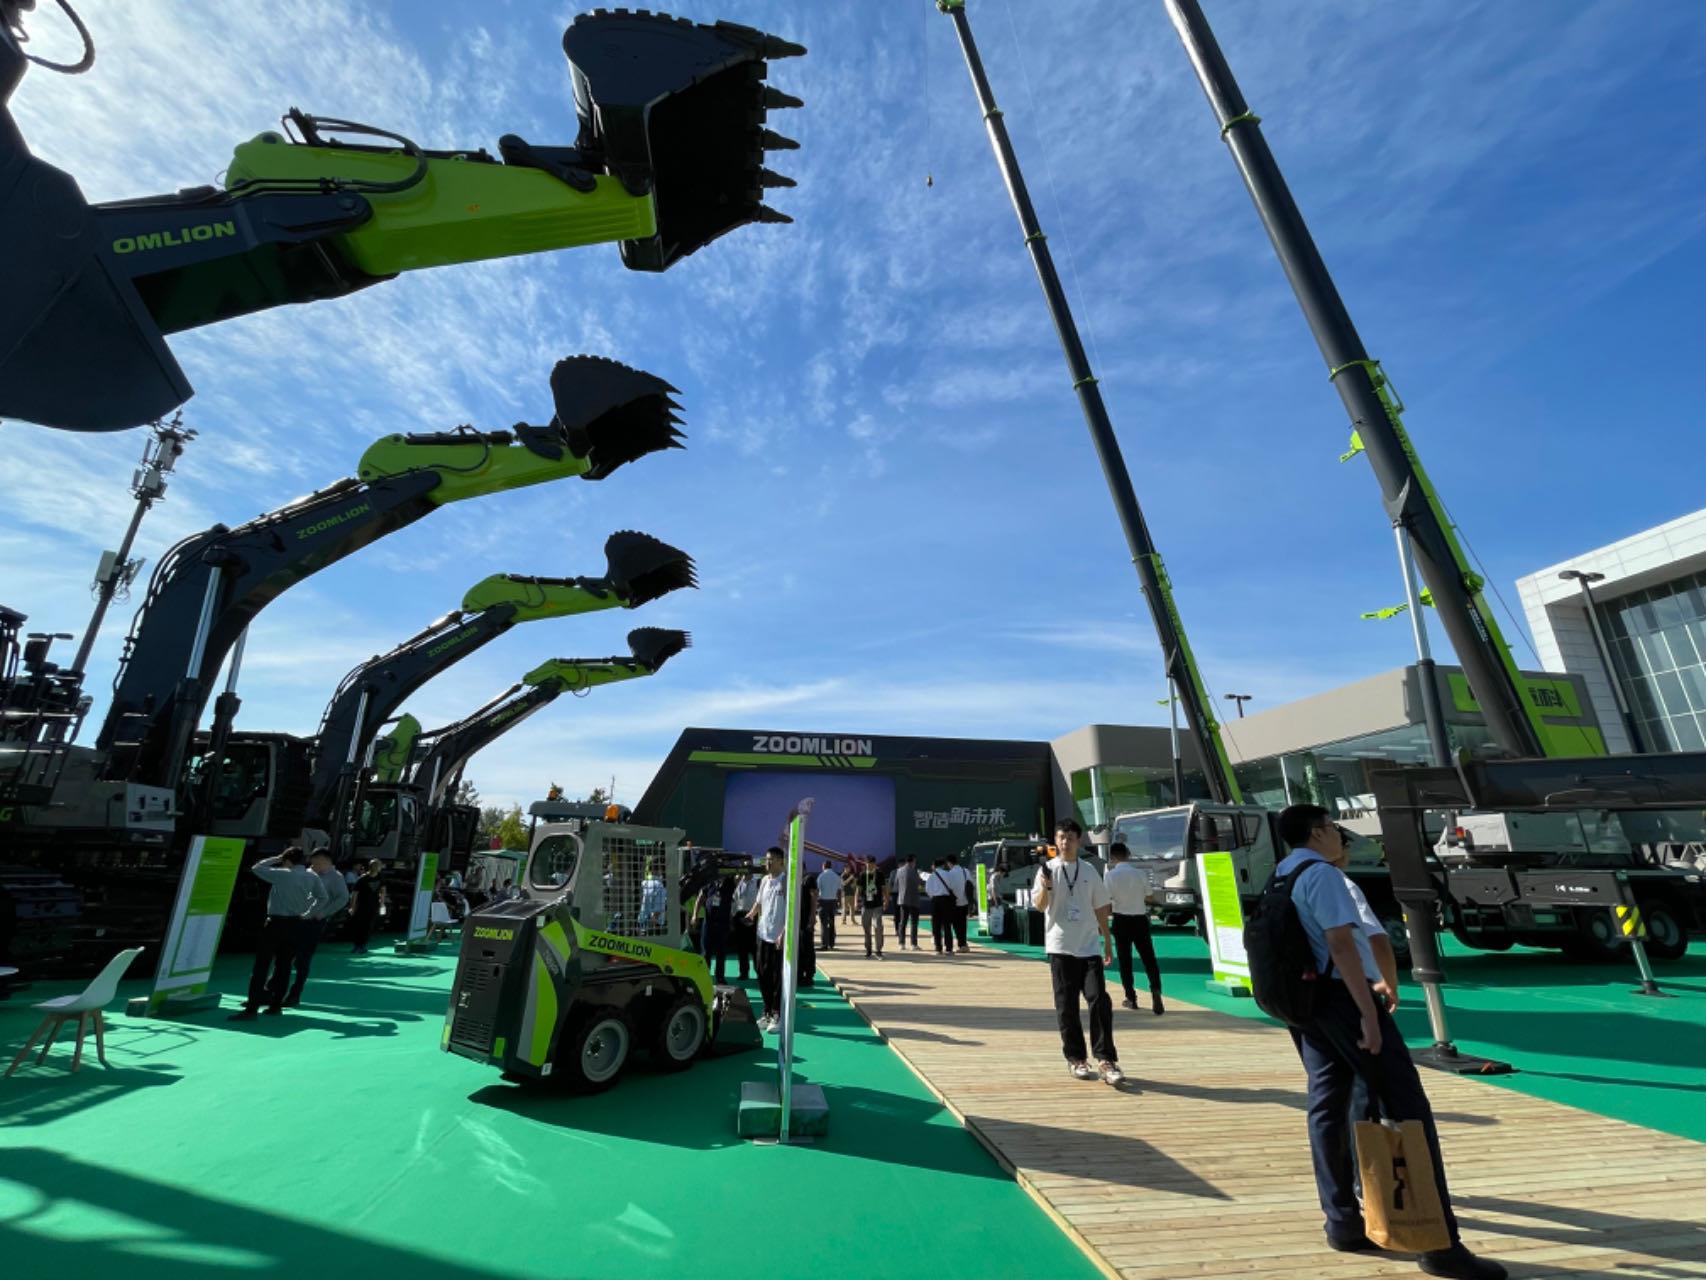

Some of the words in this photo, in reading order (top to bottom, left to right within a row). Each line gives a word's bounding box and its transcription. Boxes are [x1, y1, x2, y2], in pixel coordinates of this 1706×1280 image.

[296, 503, 369, 540] ZOOMLION
[753, 736, 872, 755] ZOOMLION
[473, 926, 513, 941] ZOOMLION
[589, 935, 653, 957] ZOOMLION
